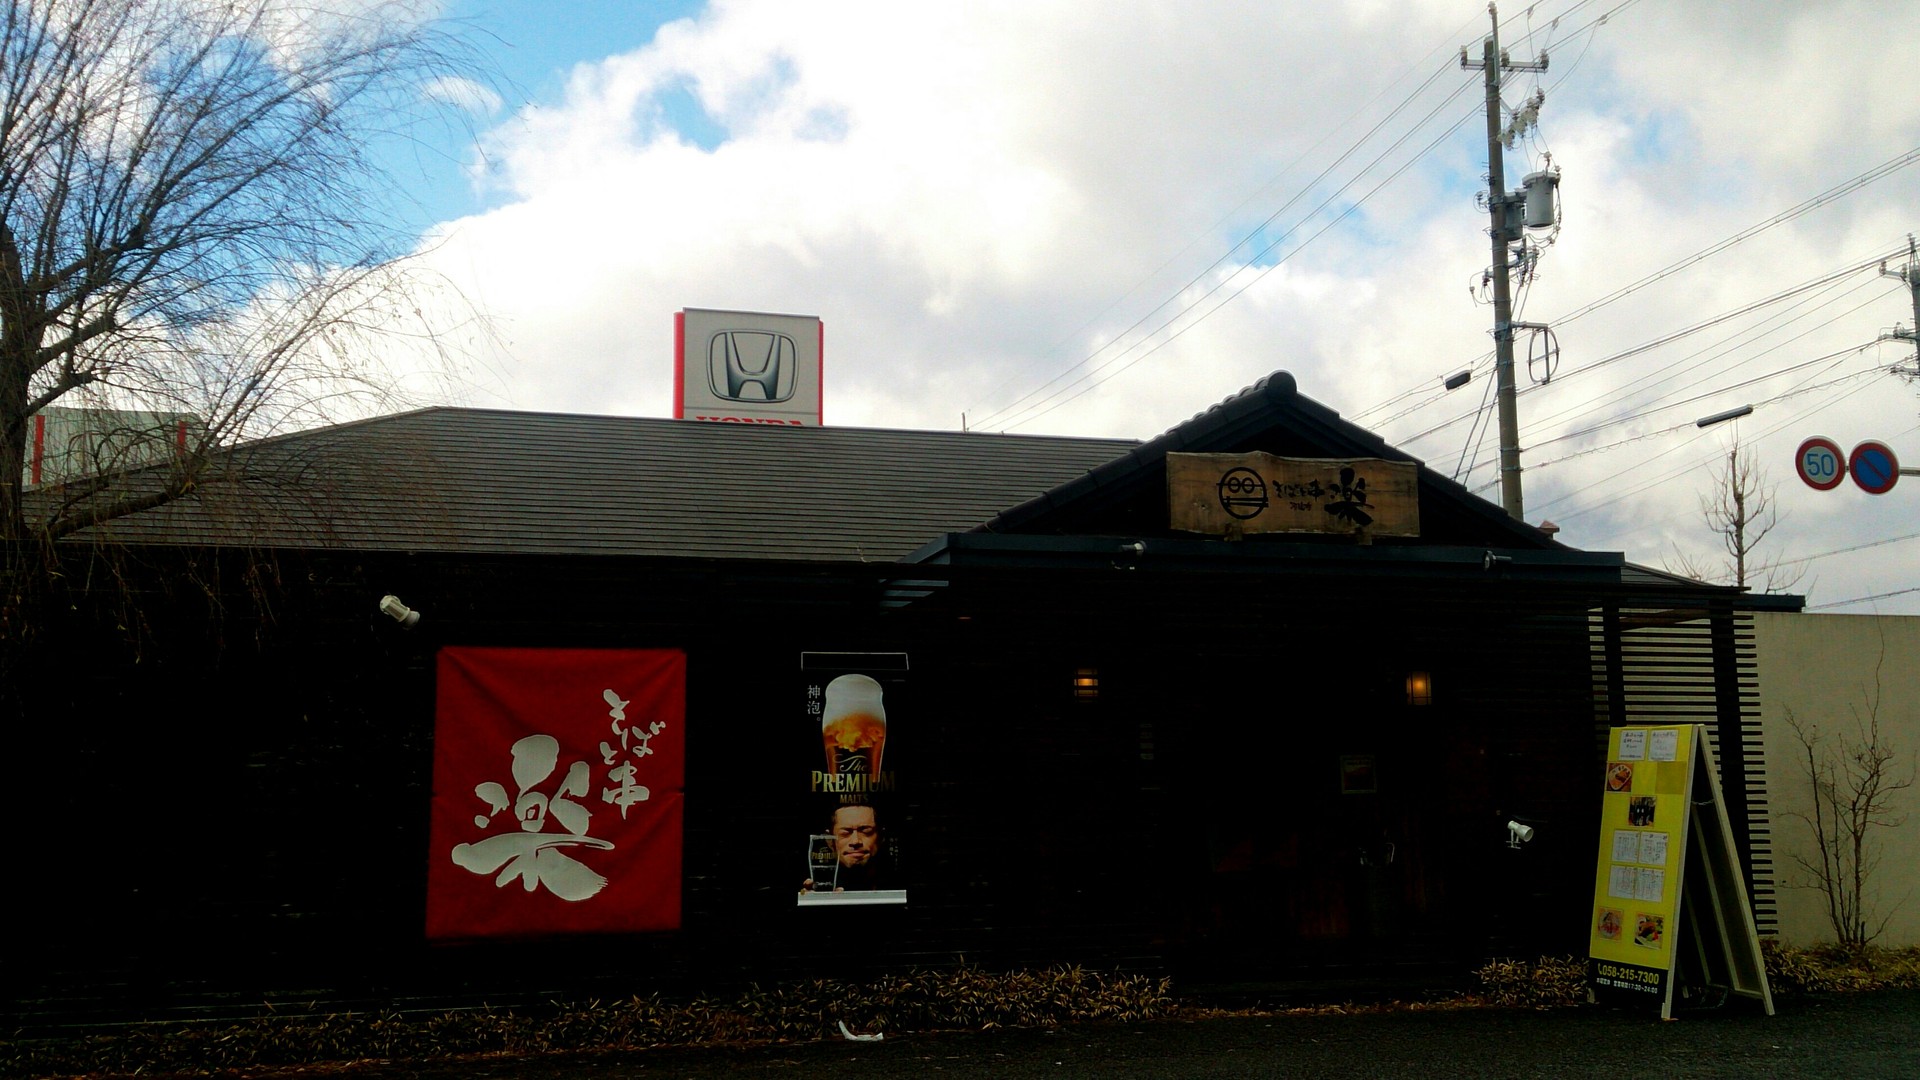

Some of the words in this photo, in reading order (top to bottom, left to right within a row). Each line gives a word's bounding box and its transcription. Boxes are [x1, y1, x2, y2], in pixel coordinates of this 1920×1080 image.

[1806, 453, 1834, 476] 50
[836, 753, 869, 773] The
[811, 769, 896, 793] PREMIUM
[451, 734, 616, 902] 楽
[1602, 965, 1659, 984] 058-215-7300
